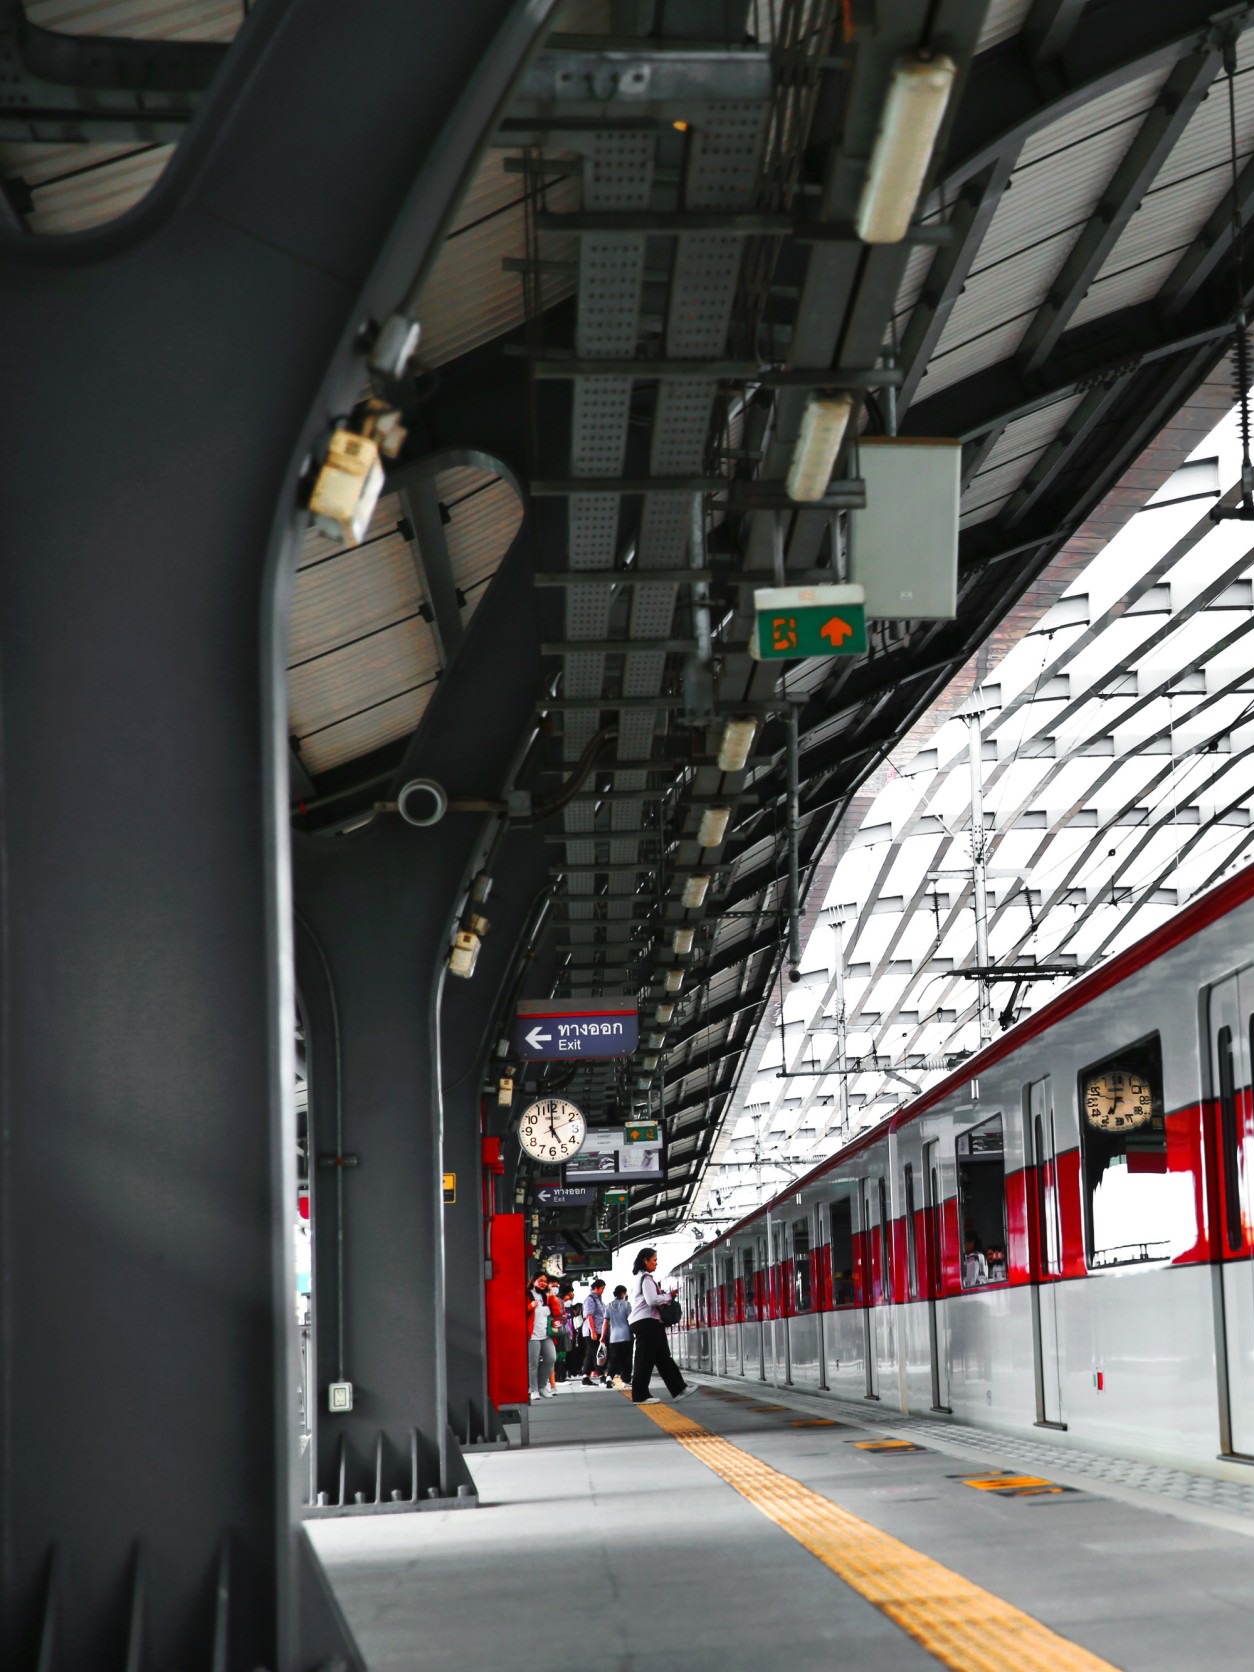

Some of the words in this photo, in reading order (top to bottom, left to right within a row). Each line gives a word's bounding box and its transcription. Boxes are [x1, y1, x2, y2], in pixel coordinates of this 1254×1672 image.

[558, 1023, 623, 1037] ทางออก
[558, 1039, 581, 1051] Exit
[537, 1106, 545, 1116] 11
[527, 1115, 538, 1125] 10
[568, 1112, 576, 1122] 2
[525, 1126, 533, 1136] 9
[530, 1137, 537, 1147] 8
[568, 1135, 576, 1144] 4
[539, 1144, 546, 1154] 7
[549, 1147, 557, 1156] 6
[561, 1143, 568, 1153] 5
